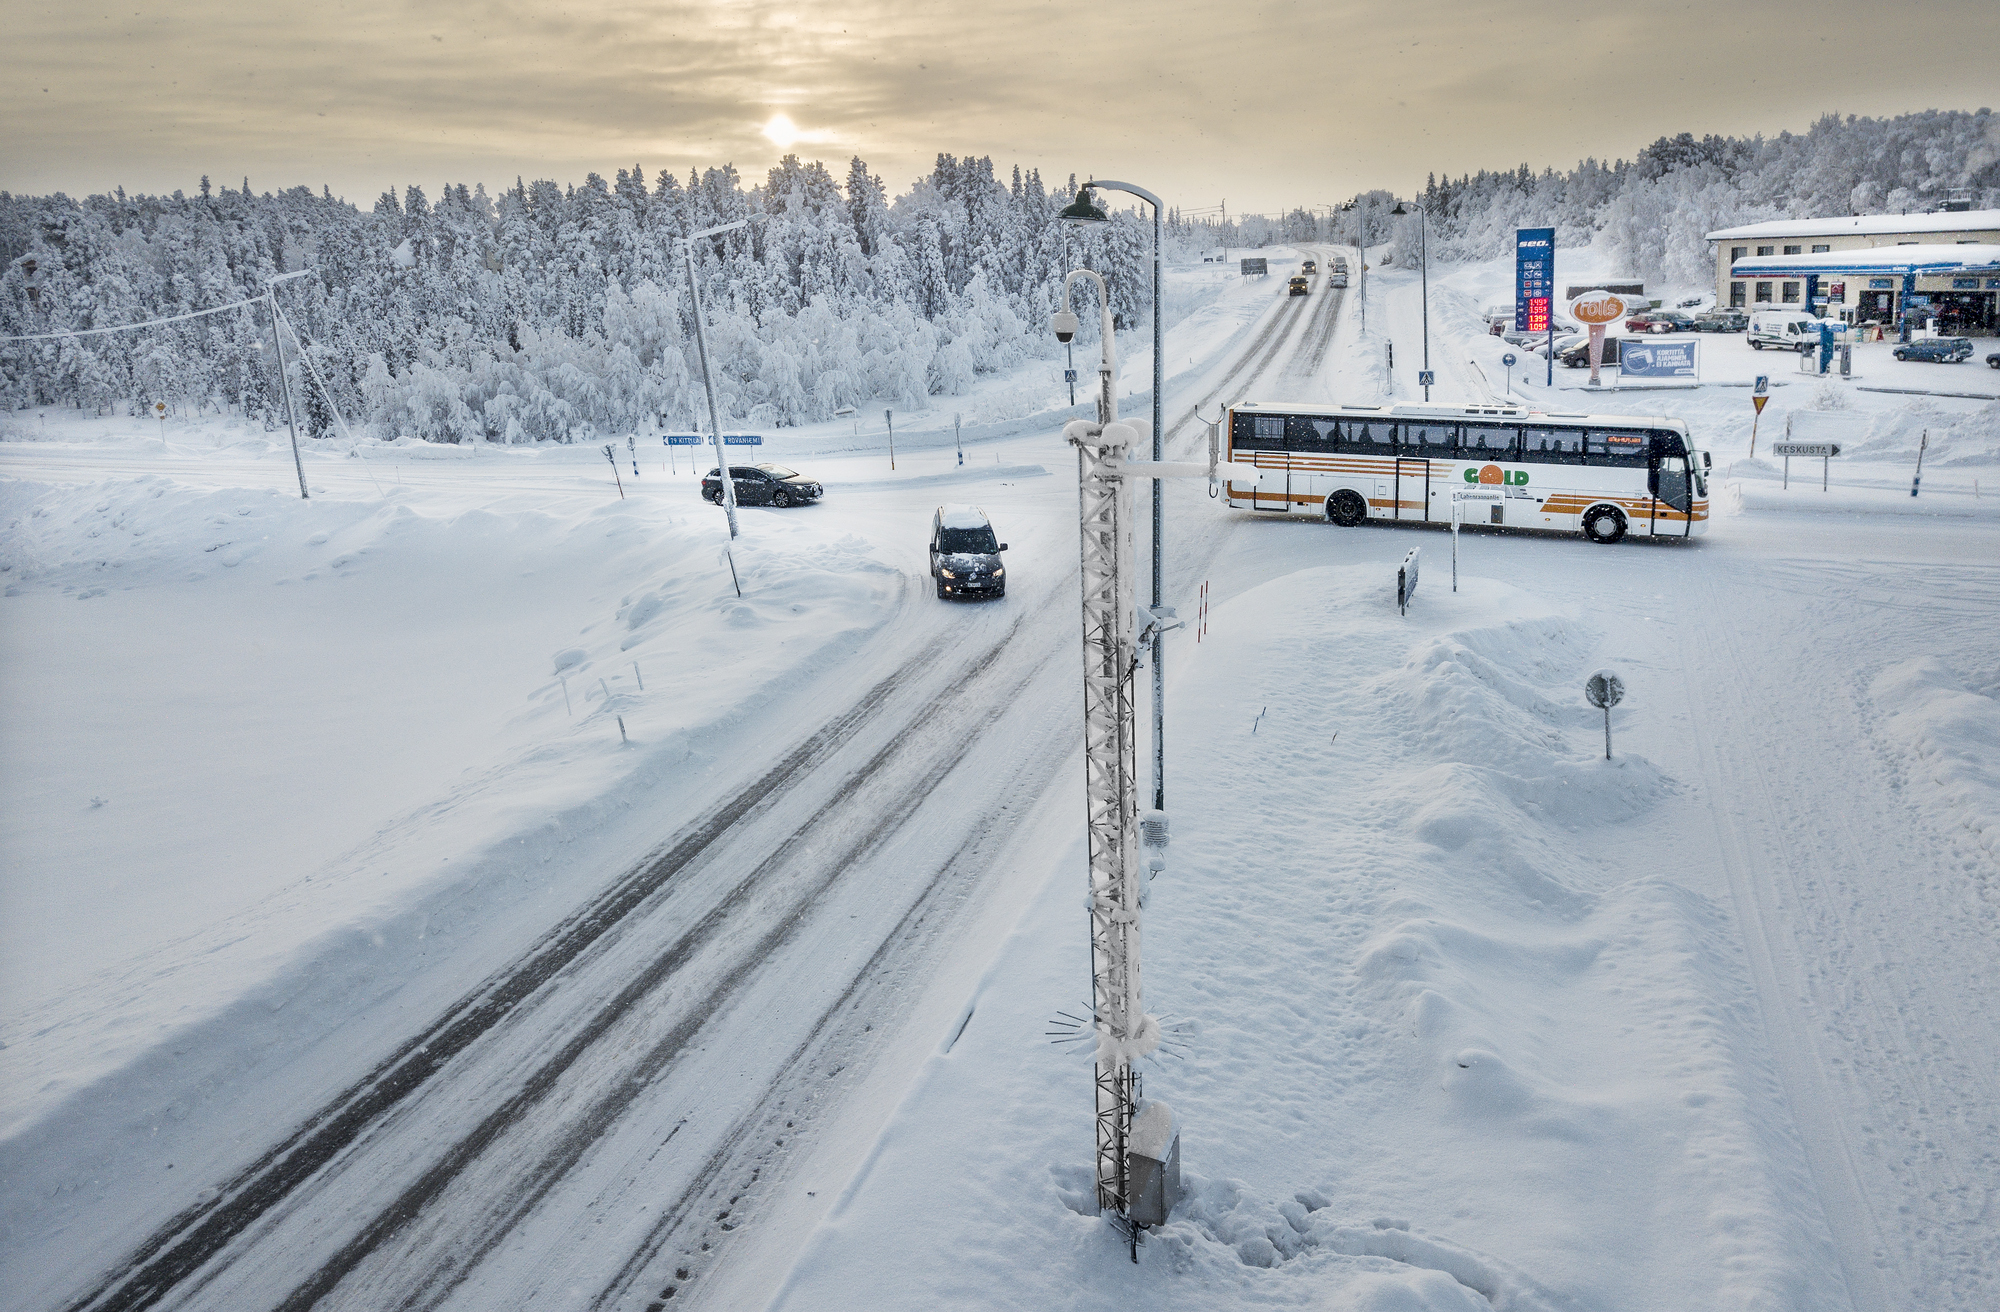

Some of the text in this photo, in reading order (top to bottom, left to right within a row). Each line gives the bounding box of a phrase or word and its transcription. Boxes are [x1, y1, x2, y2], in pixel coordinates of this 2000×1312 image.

[1579, 299, 1617, 316] rolls
[1656, 354, 1687, 362] AJAMINEN
[1777, 445, 1827, 454] KESKUSTA
[1463, 464, 1529, 486] GOLD
